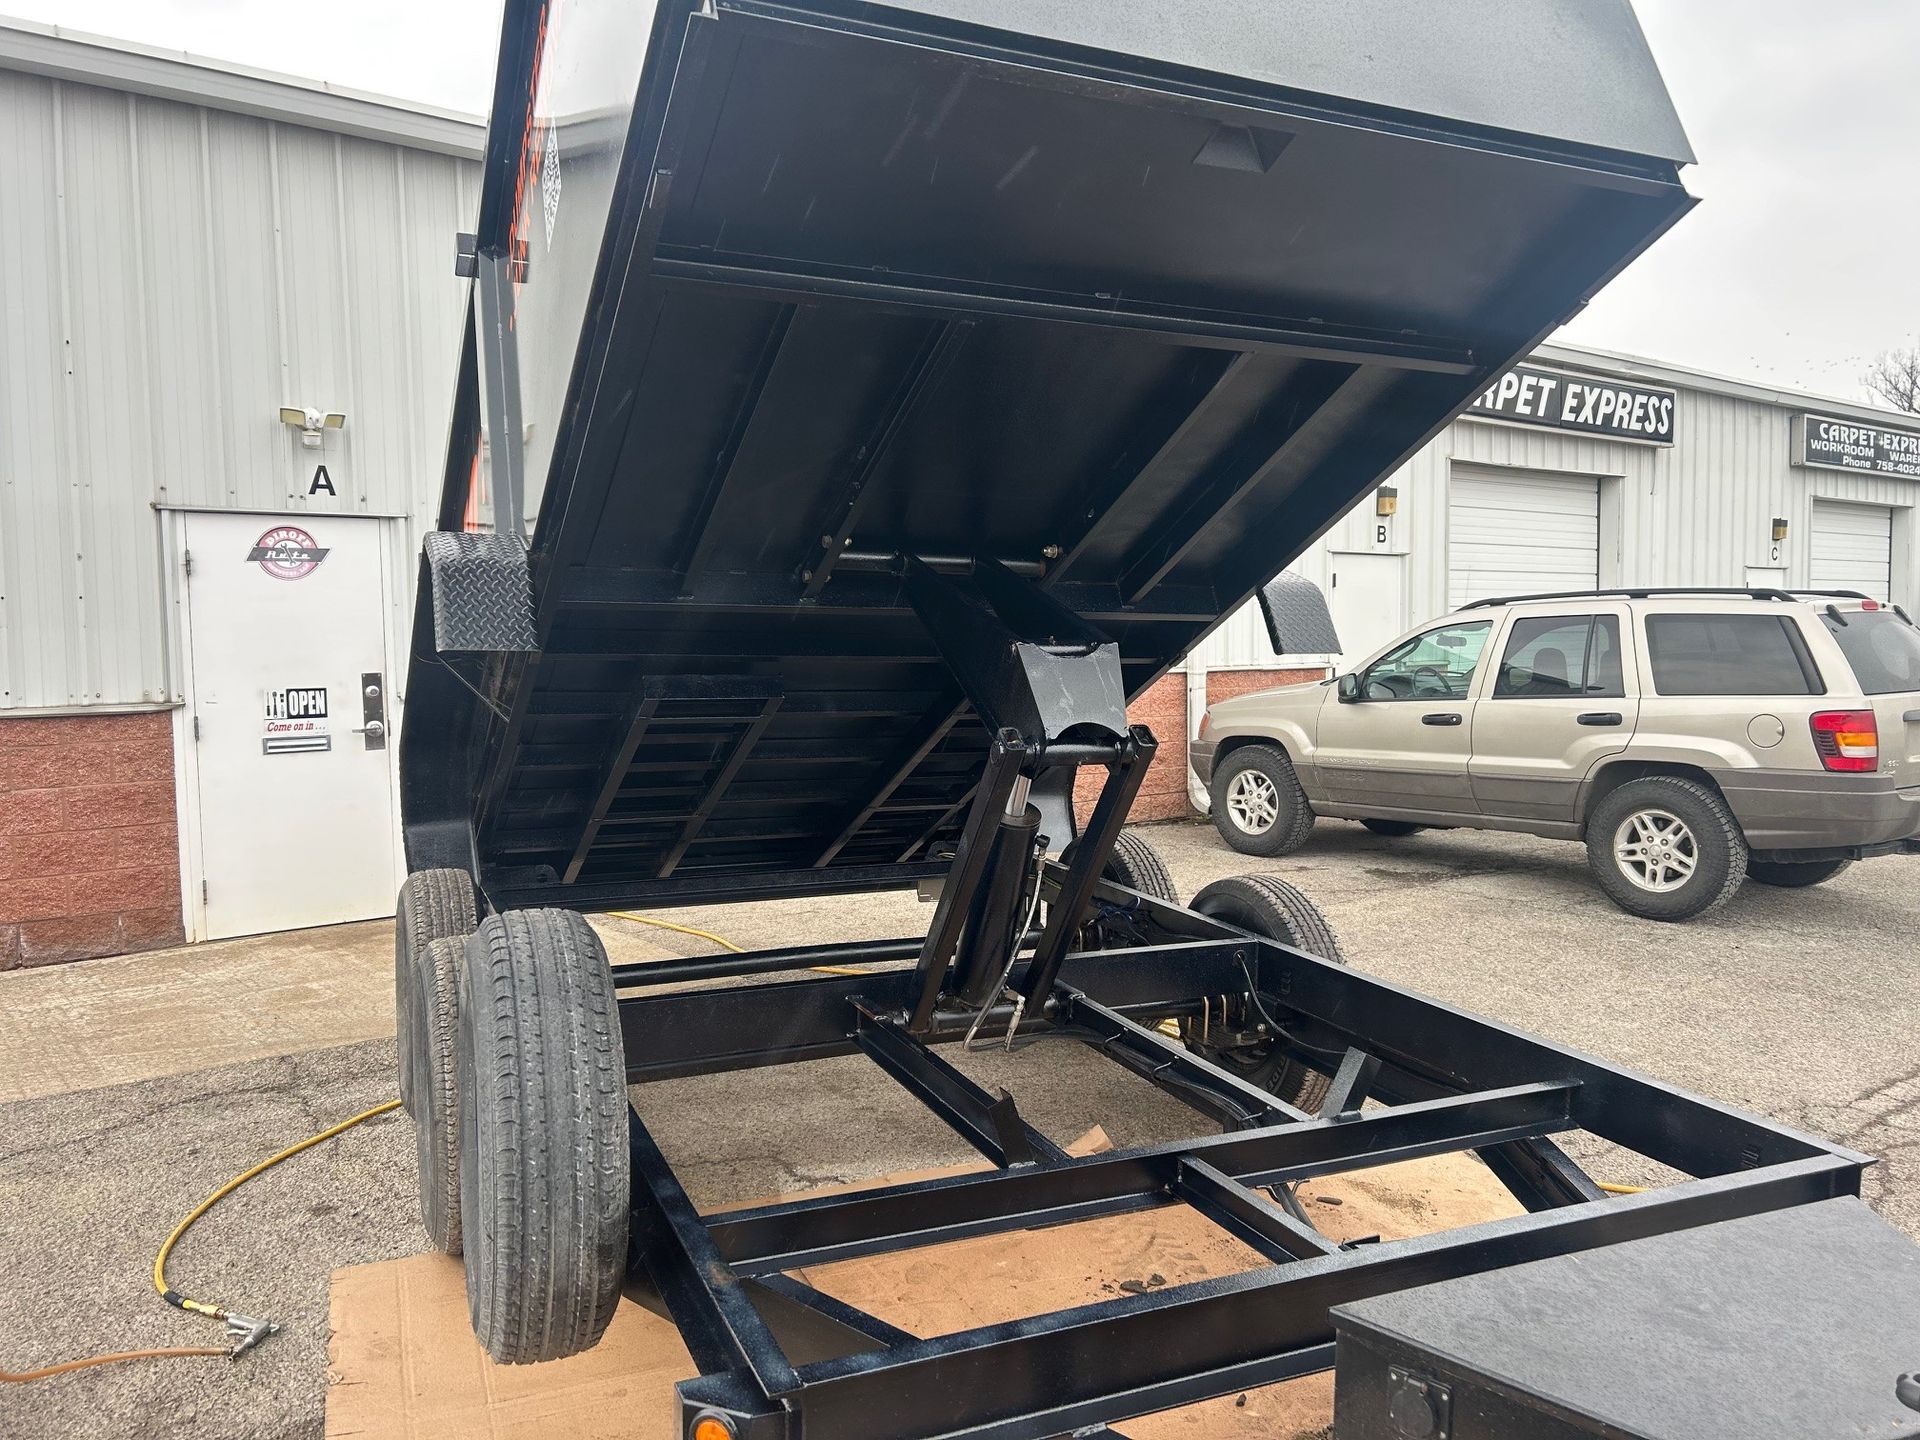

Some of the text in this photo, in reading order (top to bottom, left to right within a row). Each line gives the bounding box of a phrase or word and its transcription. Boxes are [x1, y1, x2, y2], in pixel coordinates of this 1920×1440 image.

[1561, 383, 1671, 435] EXPRESS
[1819, 423, 1877, 447] CARPET
[1811, 439, 1875, 458] WORKROOM
[1842, 455, 1920, 475] Phone 758-4024
[308, 464, 337, 496] A
[1377, 525, 1387, 543] B
[264, 550, 311, 560] Auto
[1771, 546, 1778, 561] C
[288, 690, 326, 716] OPEN
[267, 722, 292, 732] Come
[293, 723, 304, 731] on
